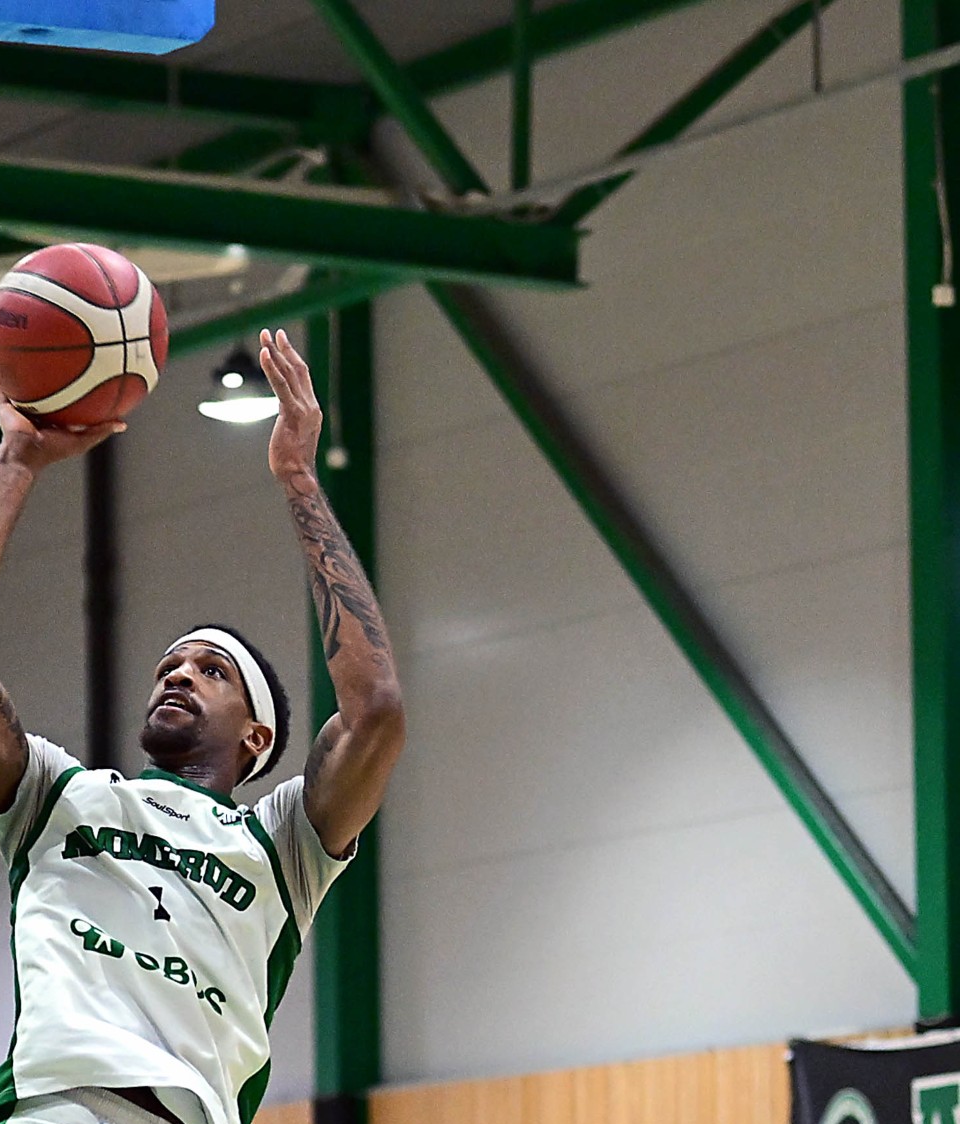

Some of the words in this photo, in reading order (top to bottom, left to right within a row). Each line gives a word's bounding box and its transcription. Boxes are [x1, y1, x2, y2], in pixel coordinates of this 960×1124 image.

[142, 796, 191, 822] SoulSport
[61, 825, 257, 912] AMMERUD
[147, 886, 171, 922] 1
